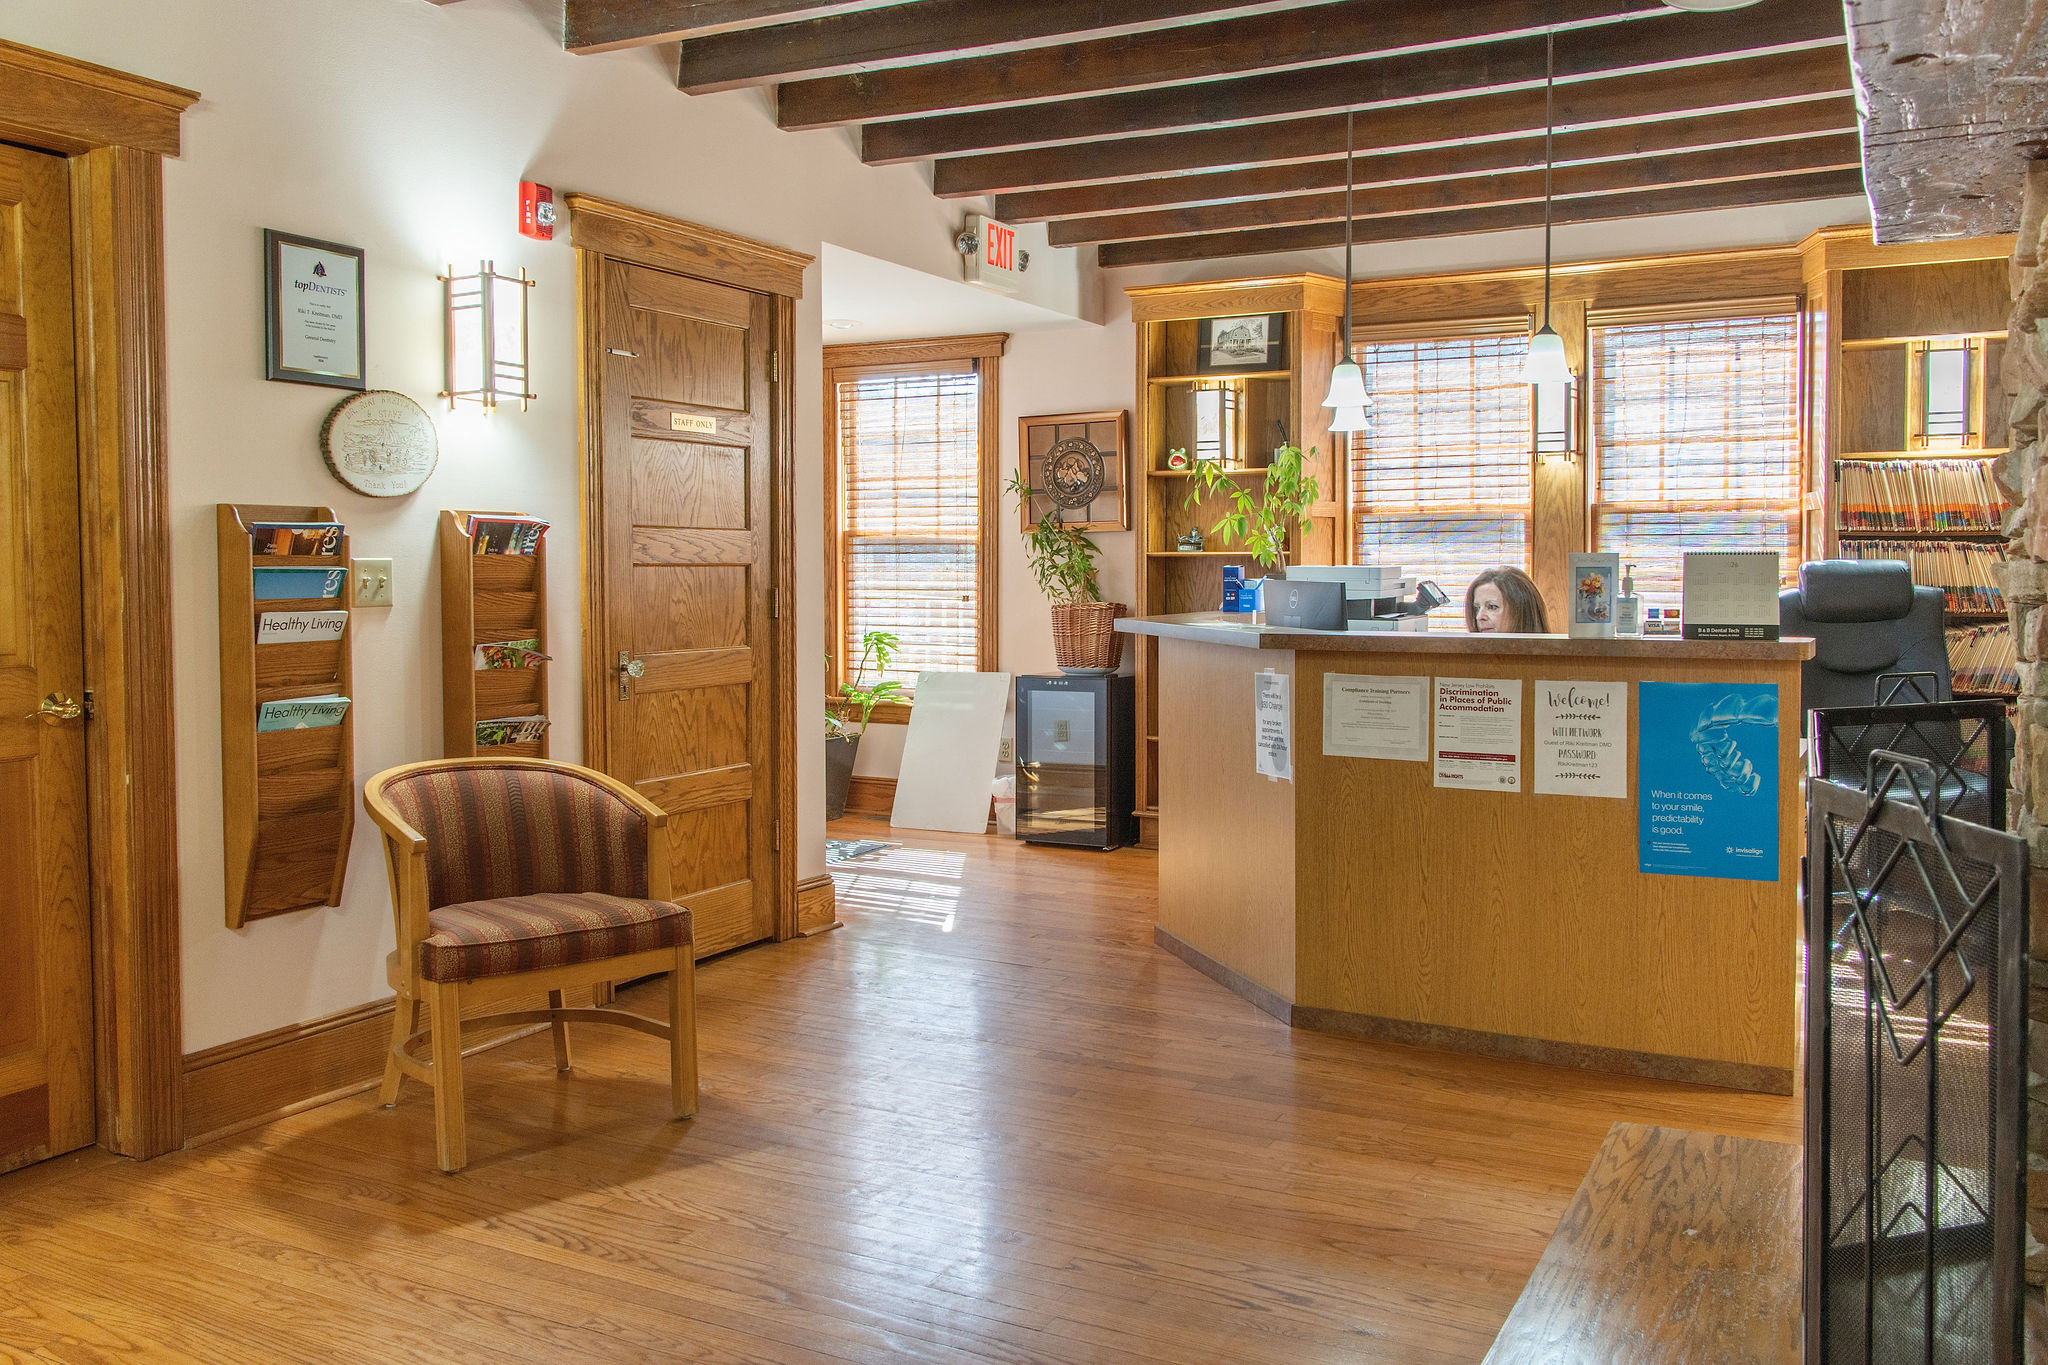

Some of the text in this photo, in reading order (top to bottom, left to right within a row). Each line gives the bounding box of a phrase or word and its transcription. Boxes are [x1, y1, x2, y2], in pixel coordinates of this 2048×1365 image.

[987, 222, 1015, 271] EXIT
[673, 417, 714, 430] STAFF ONLY
[364, 479, 407, 490] Thank You!
[262, 617, 344, 634] Healthy Living
[1439, 687, 1499, 697] Discrimination
[1547, 686, 1610, 709] Welcome!
[1439, 695, 1448, 703] in
[1449, 695, 1475, 704] Places
[1487, 697, 1512, 705] Public
[264, 704, 345, 719] Healthy Living
[1439, 703, 1505, 713] Accommodation
[1552, 727, 1603, 738] WIFI NETWORK
[1558, 748, 1596, 760] PASSWORD
[1651, 789, 1713, 800] When it comes
[1651, 802, 1705, 813] to your smile,
[1651, 814, 1704, 826] predictability
[1651, 825, 1684, 836] is good.
[1735, 847, 1764, 855] invisalign
